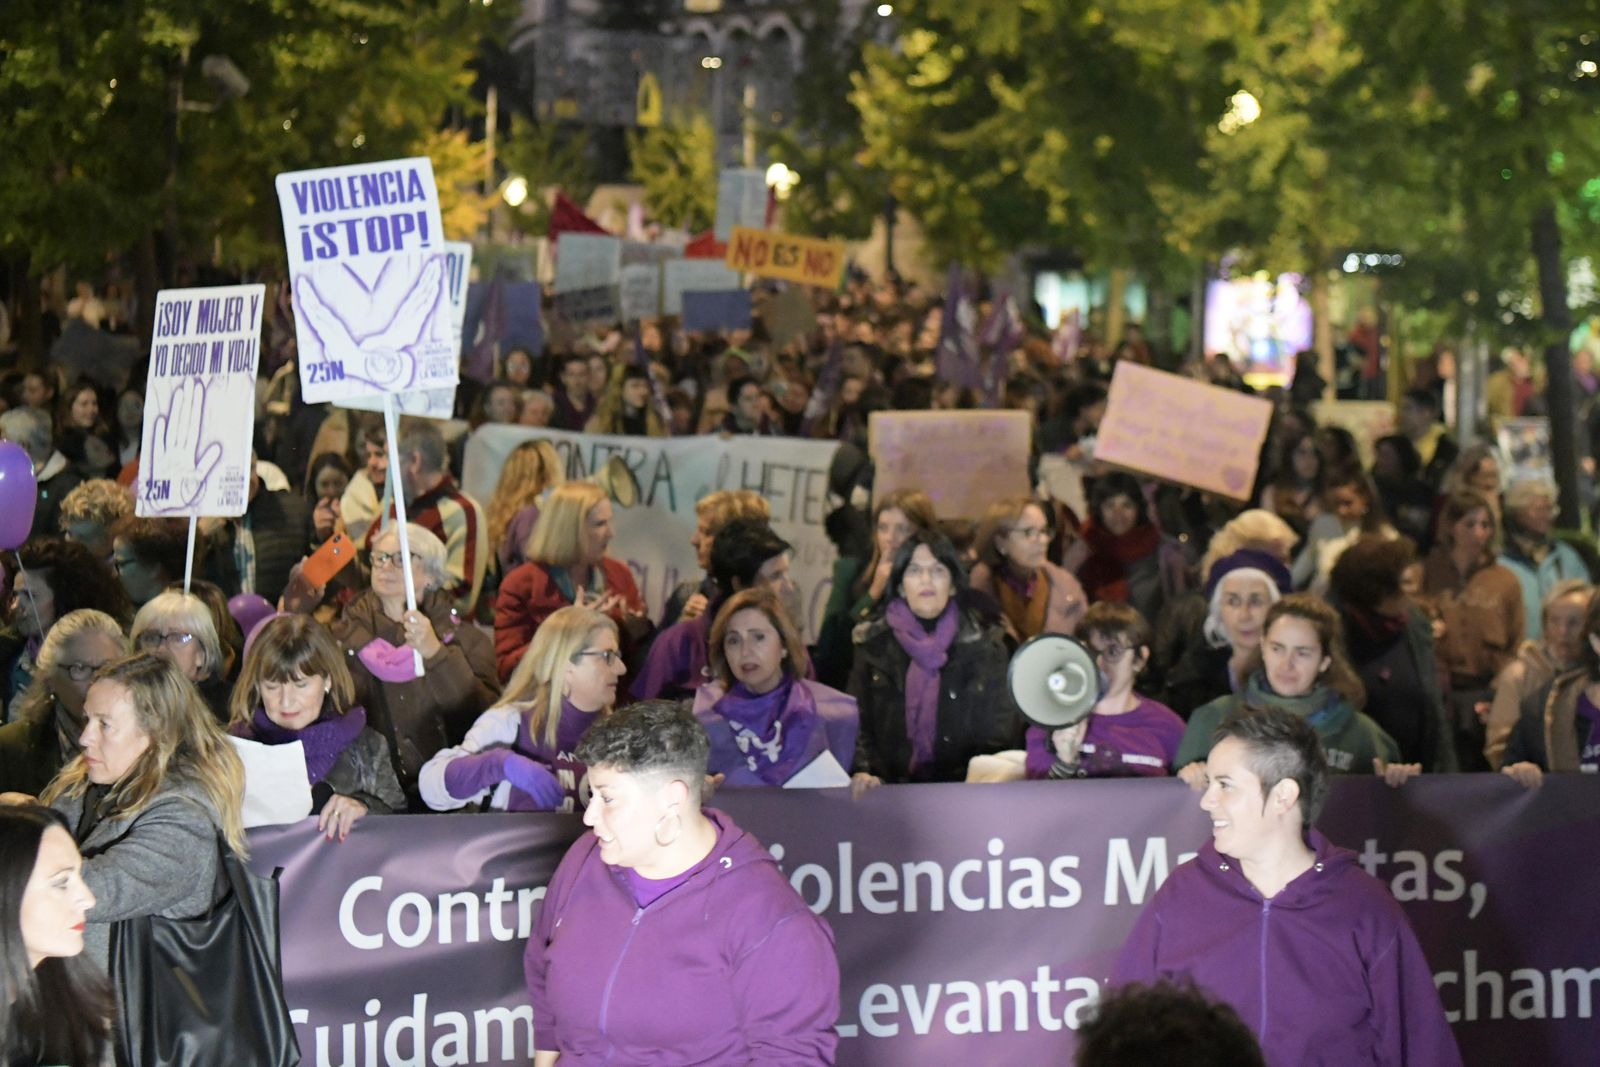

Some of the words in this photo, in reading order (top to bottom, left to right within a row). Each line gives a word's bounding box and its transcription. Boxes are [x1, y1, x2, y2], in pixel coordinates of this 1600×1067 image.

[291, 168, 427, 215] VIOLENCIA
[298, 210, 431, 262] ¡STOP!
[733, 232, 769, 268] NO
[773, 242, 799, 268] ES
[803, 247, 834, 278] NO
[157, 299, 193, 338] ¡SOY
[196, 296, 244, 335] MUJER
[250, 294, 260, 332] Y
[154, 343, 169, 378] YO
[170, 341, 208, 377] DECIDO
[209, 340, 225, 375] MI
[227, 338, 256, 374] VIDA!
[306, 359, 346, 385] 25N
[144, 478, 171, 501] 25N
[741, 458, 828, 525] HETE
[338, 876, 549, 951] Contr
[768, 837, 1083, 915] olencias
[288, 992, 536, 1067] uidam
[834, 965, 1108, 1038] evanta
[1432, 949, 1600, 1024] cham
